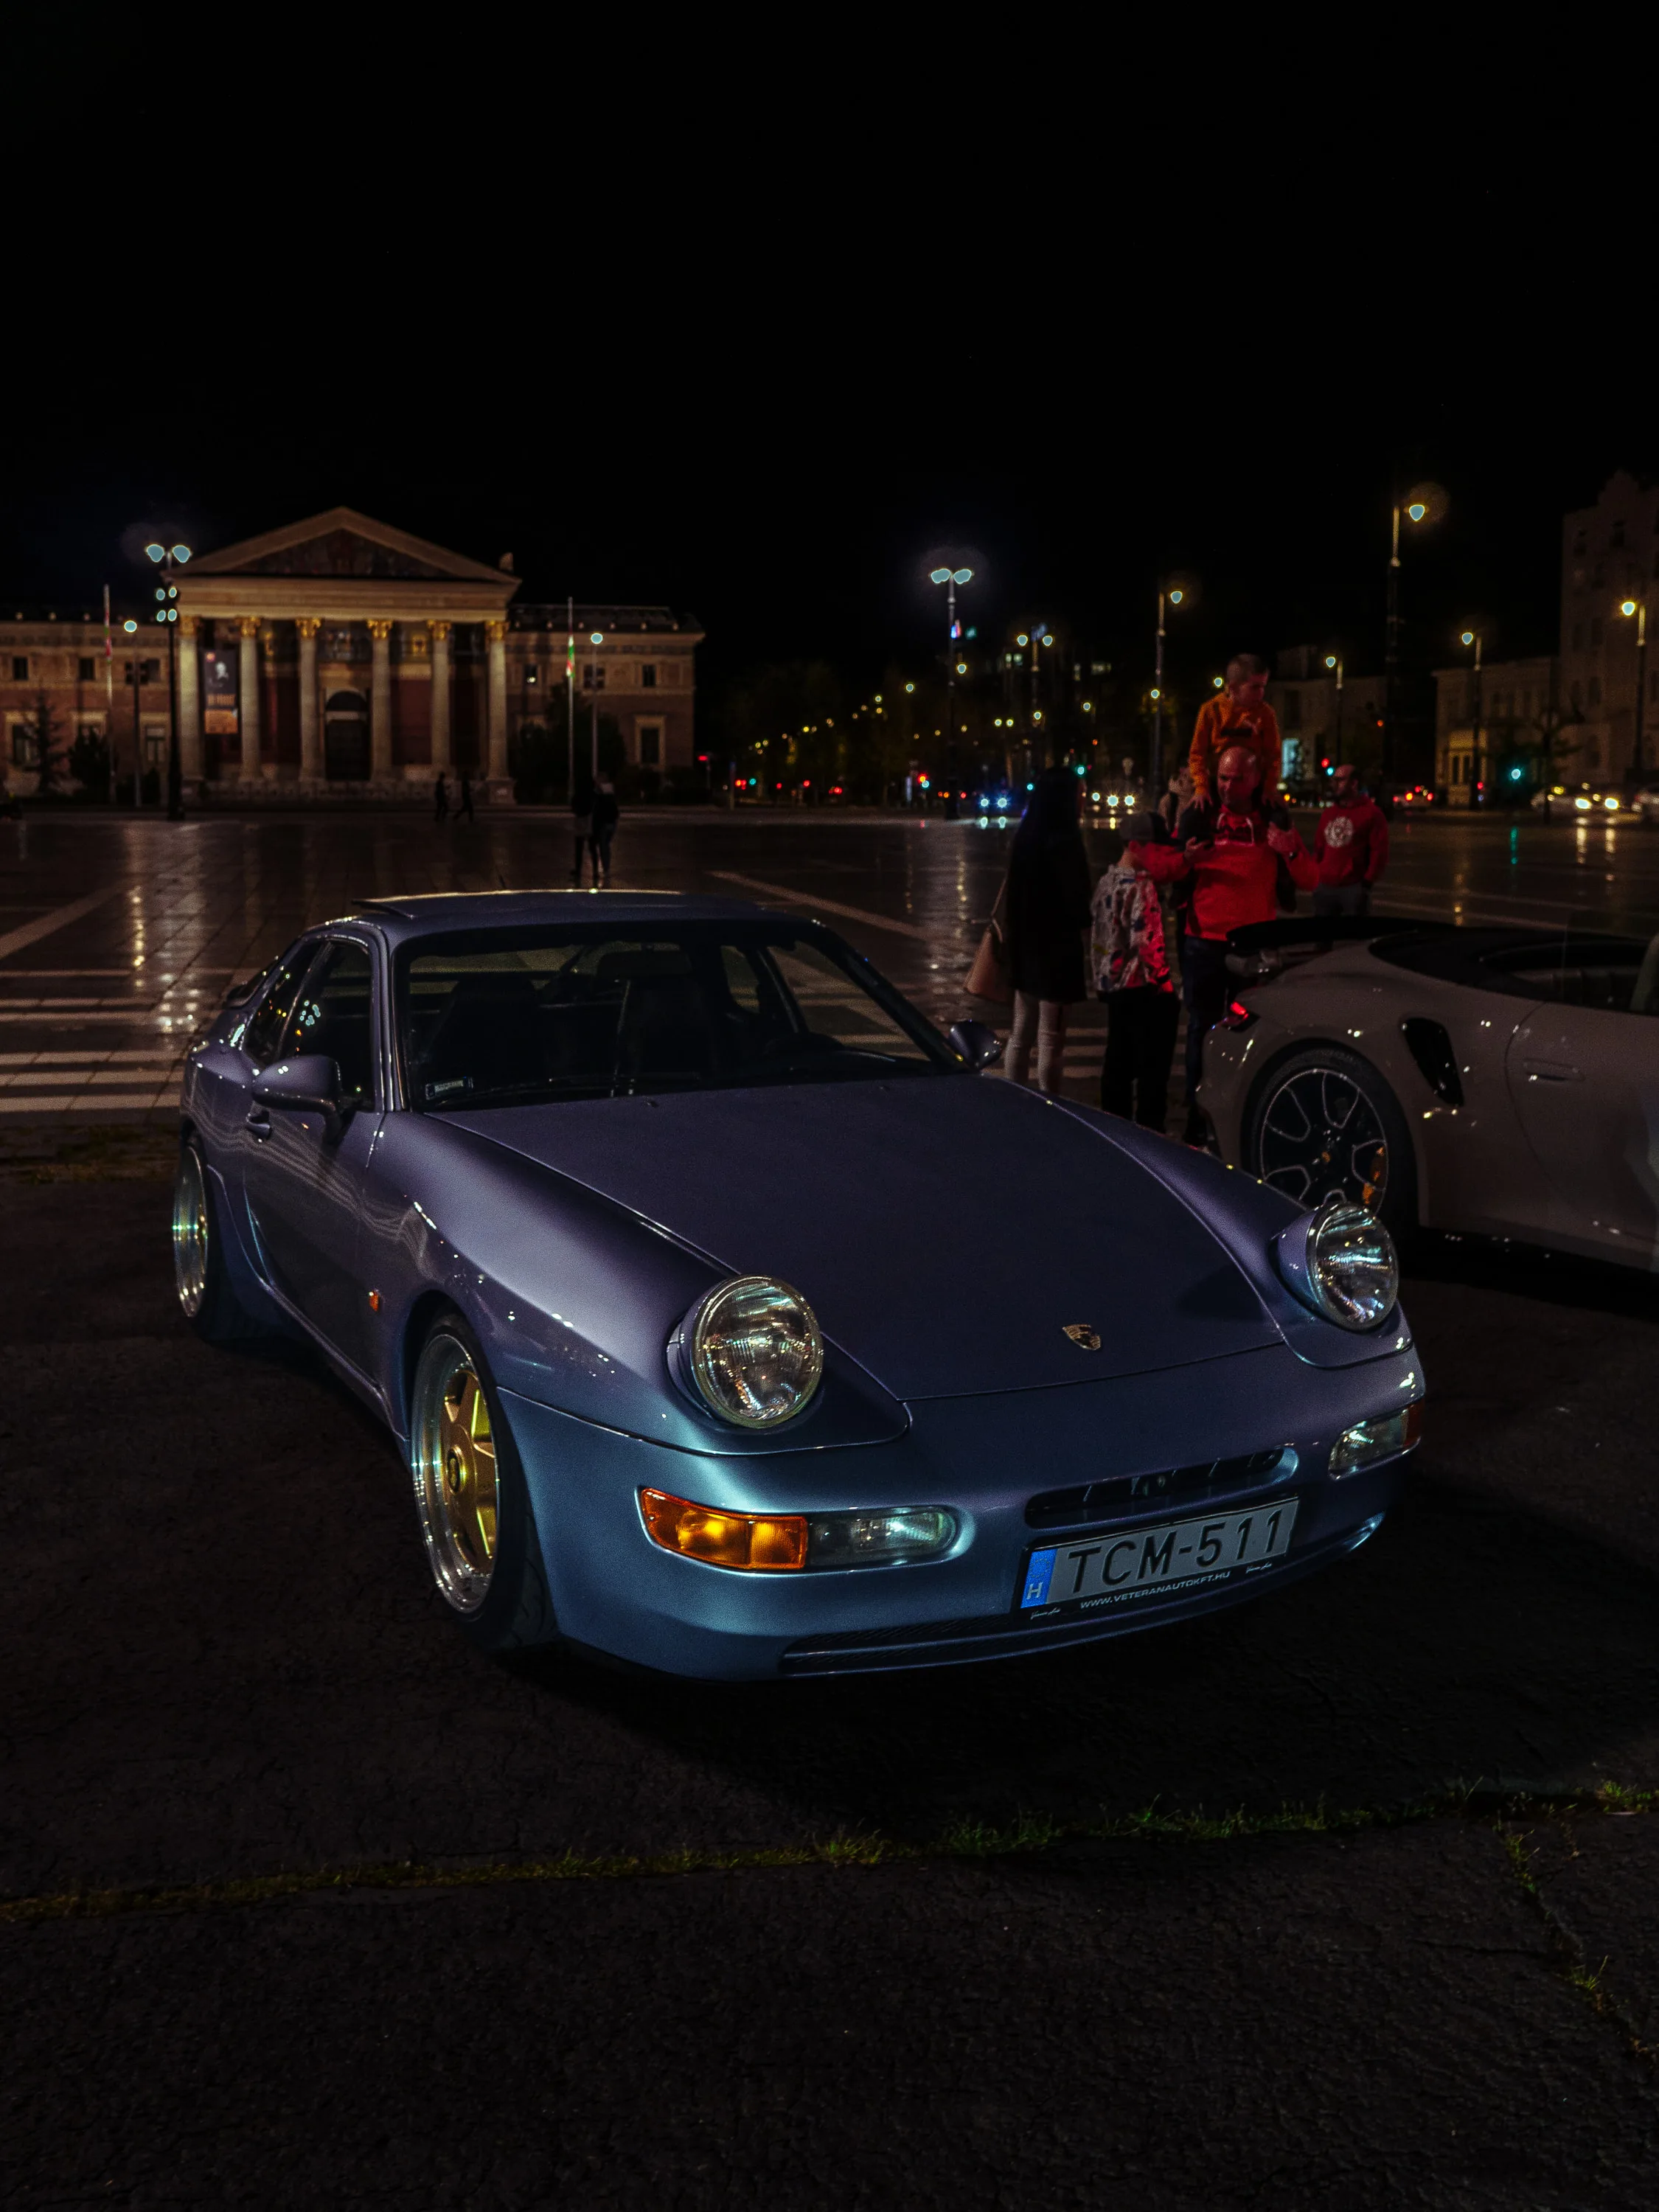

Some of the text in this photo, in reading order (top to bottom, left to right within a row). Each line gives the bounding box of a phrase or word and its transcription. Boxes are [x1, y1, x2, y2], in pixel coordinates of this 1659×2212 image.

[1068, 1509, 1281, 1593] TCM-511
[1026, 1582, 1043, 1600] H
[1080, 1571, 1232, 1610] WWW.VETERANAUTOKFT.HU
